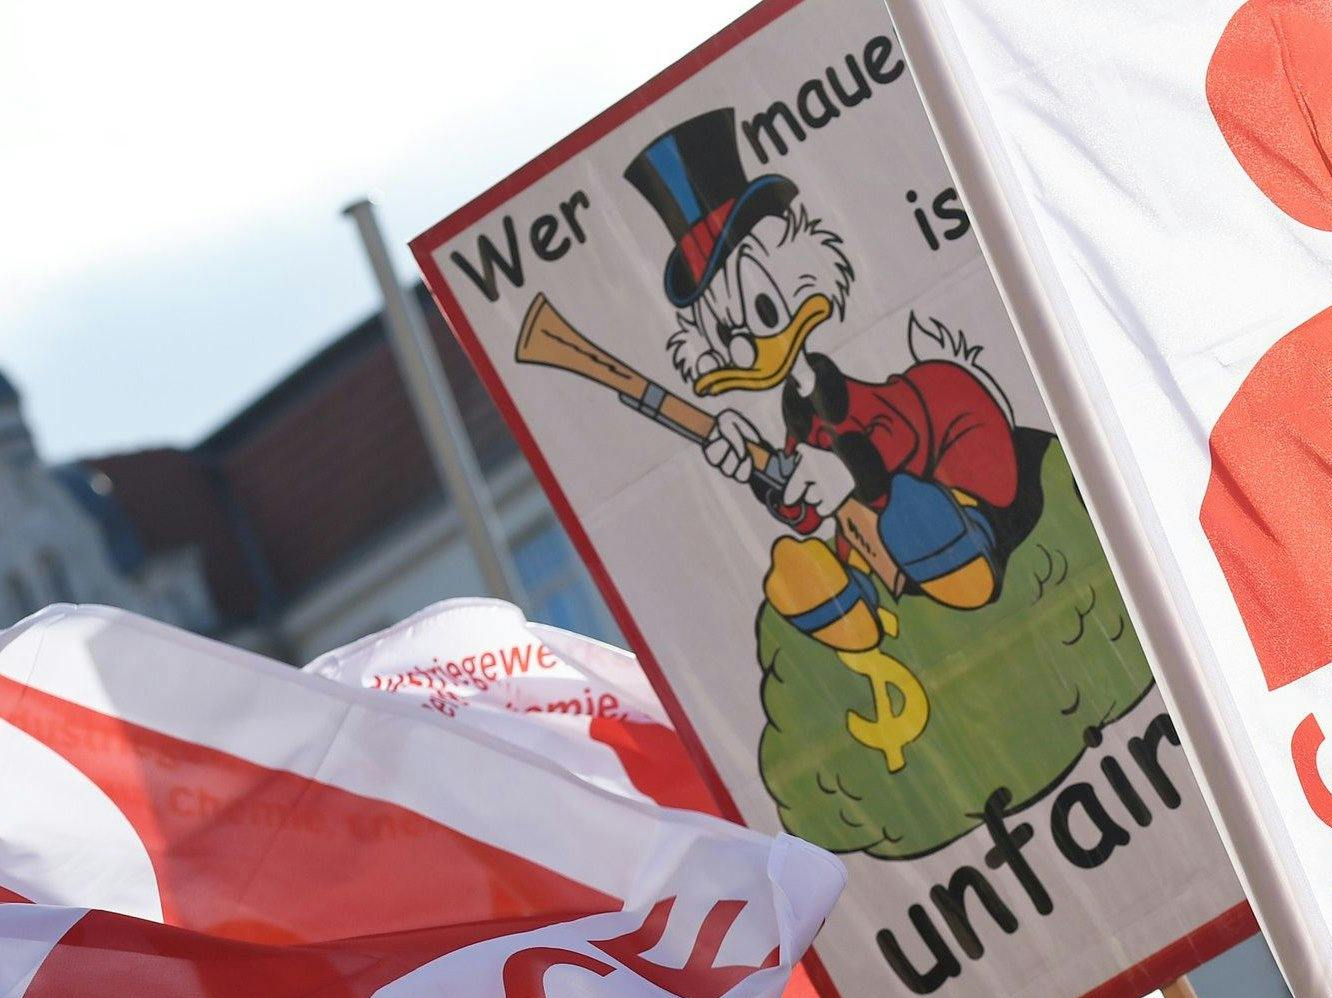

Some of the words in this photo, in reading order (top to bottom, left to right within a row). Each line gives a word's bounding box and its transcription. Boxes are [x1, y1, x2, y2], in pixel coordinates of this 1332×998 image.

[452, 190, 590, 302] Wer
[743, 35, 904, 164] maue
[906, 187, 972, 251] is
[876, 713, 1182, 995] unfair
